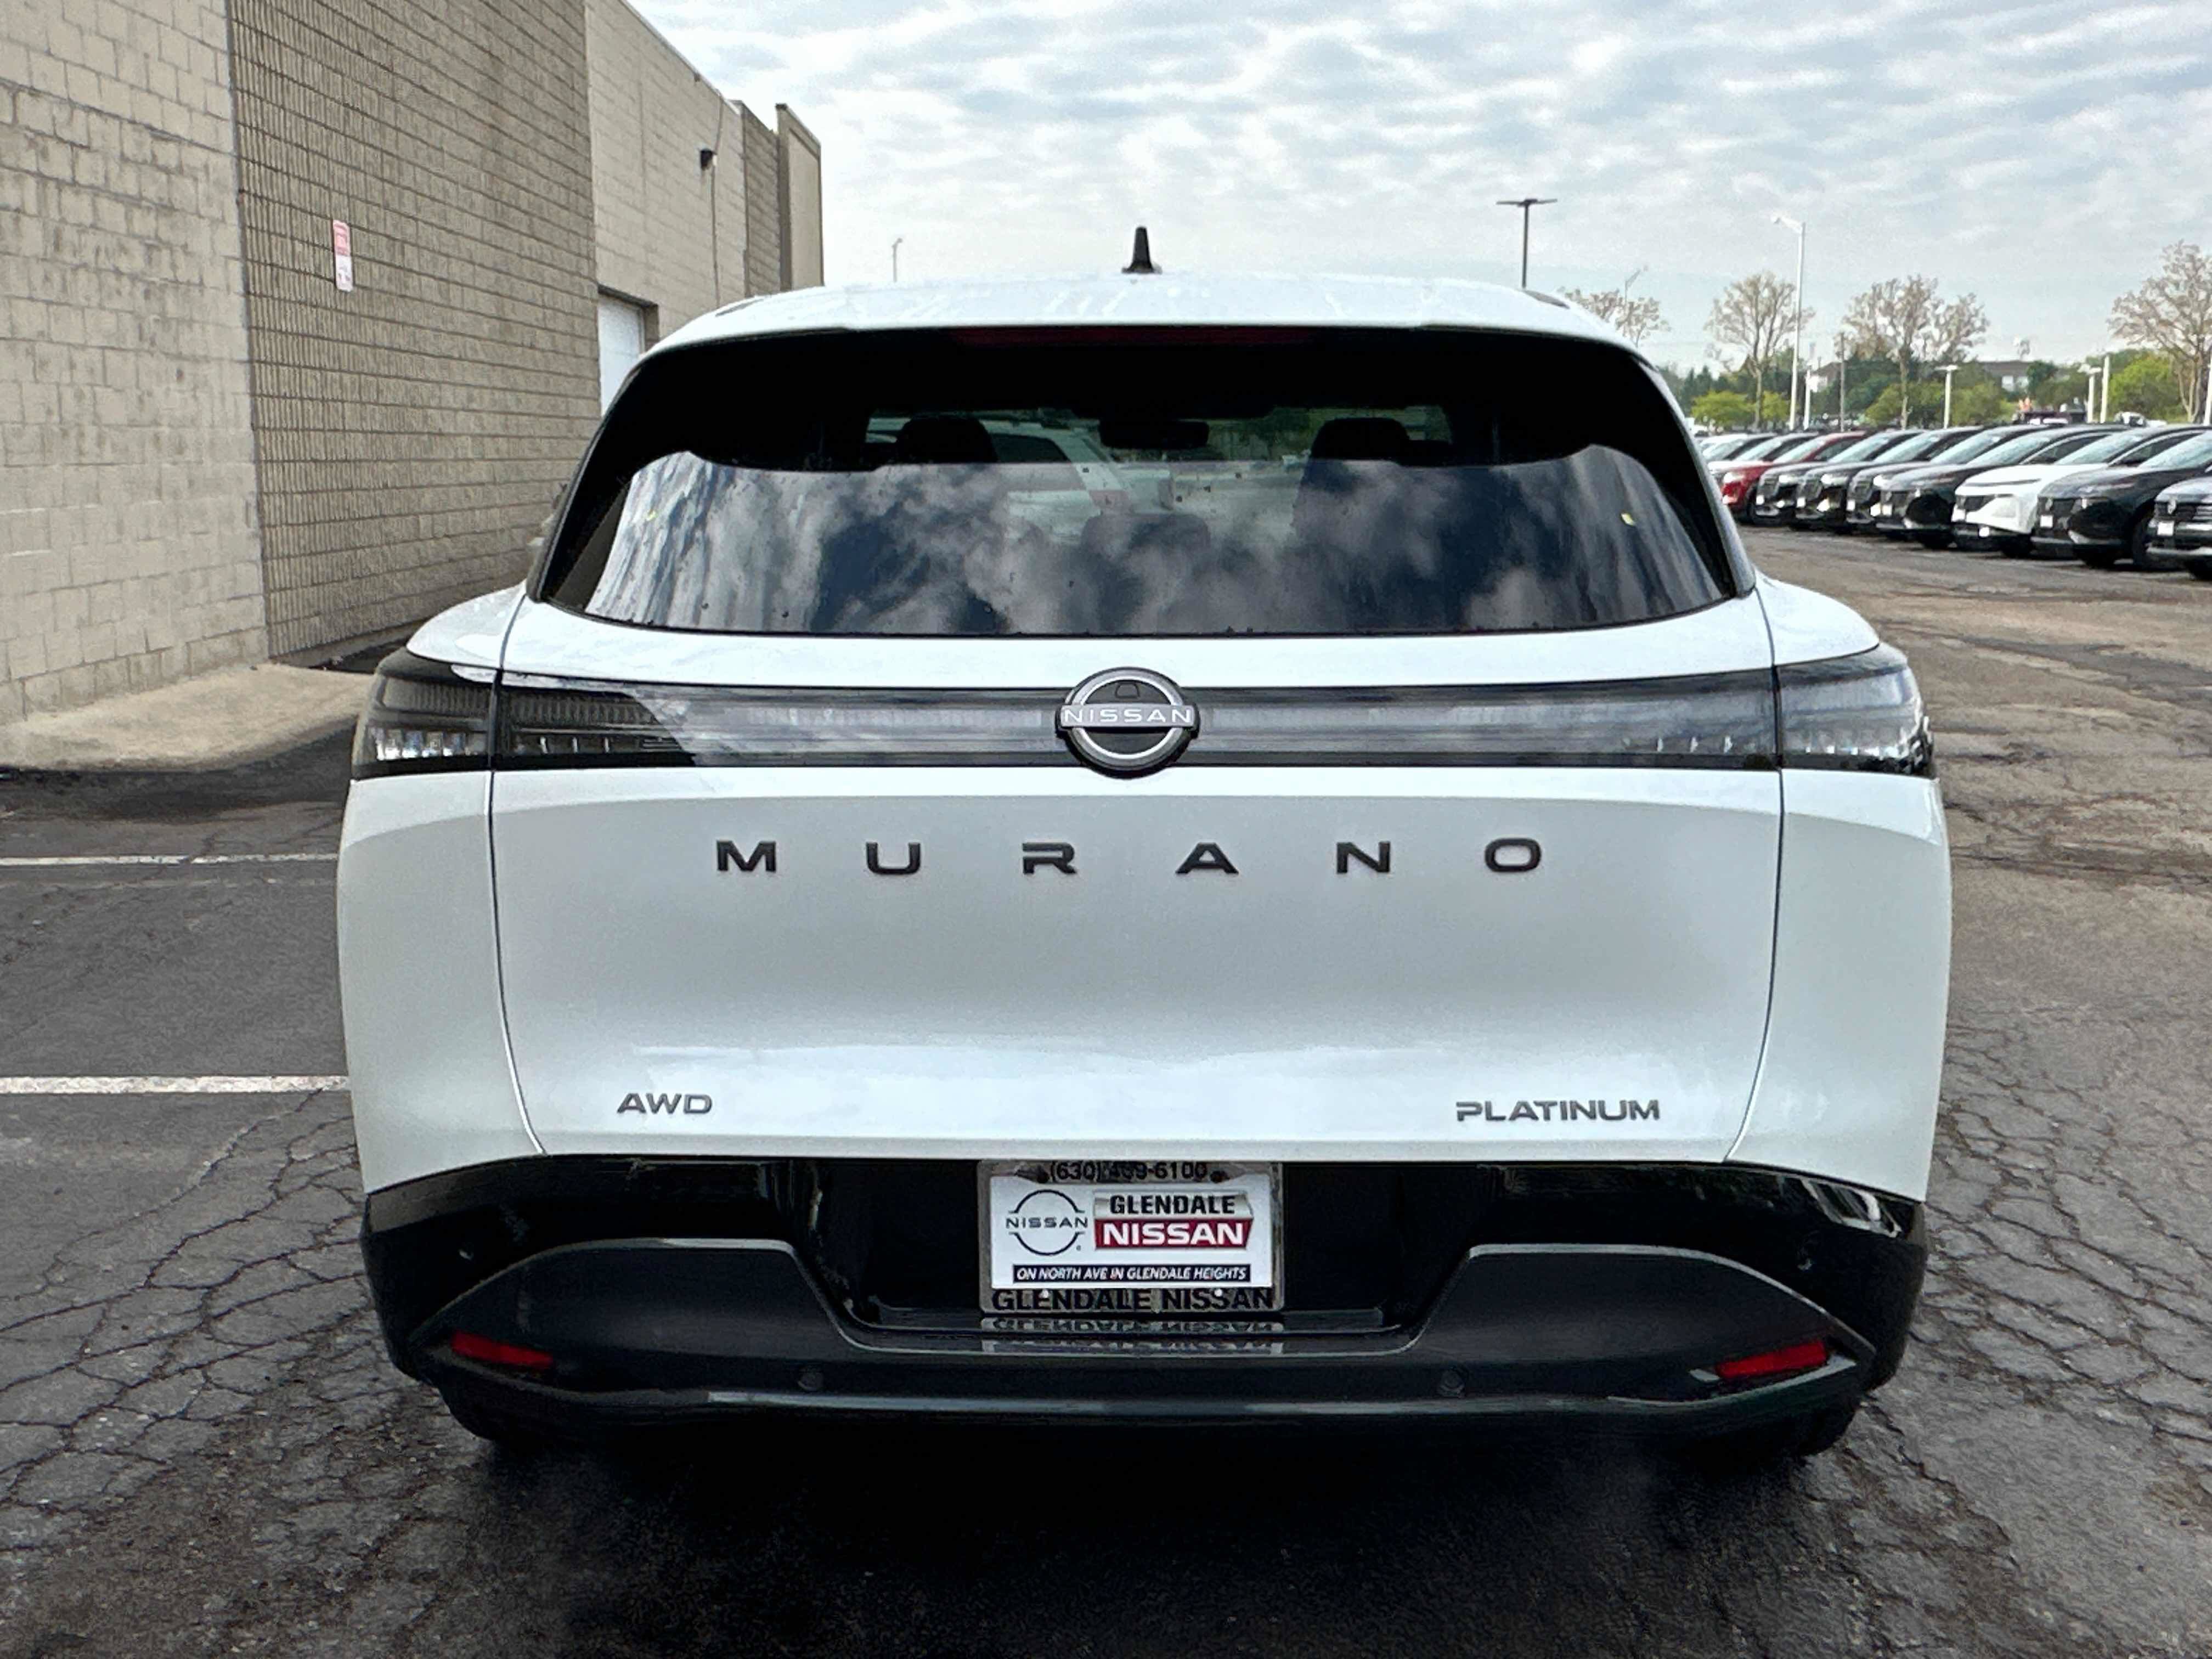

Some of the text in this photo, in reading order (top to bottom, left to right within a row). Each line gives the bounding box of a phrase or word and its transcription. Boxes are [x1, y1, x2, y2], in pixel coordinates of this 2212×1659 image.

[1064, 709, 1190, 723] NISSAN
[717, 838, 1542, 876] MURANO
[617, 1093, 713, 1114] AWD
[1455, 1099, 1661, 1122] PLATINUM
[1051, 1161, 1101, 1182] (630)
[1109, 1195, 1235, 1215] GLENDALE
[1006, 1217, 1088, 1229] NISSAN
[1103, 1223, 1243, 1245] NISSAN
[1017, 1266, 1247, 1280] ON NORTH AVE IN GLENDALE HEIGHTS
[992, 1288, 1274, 1311] GLENDALE NISSAN
